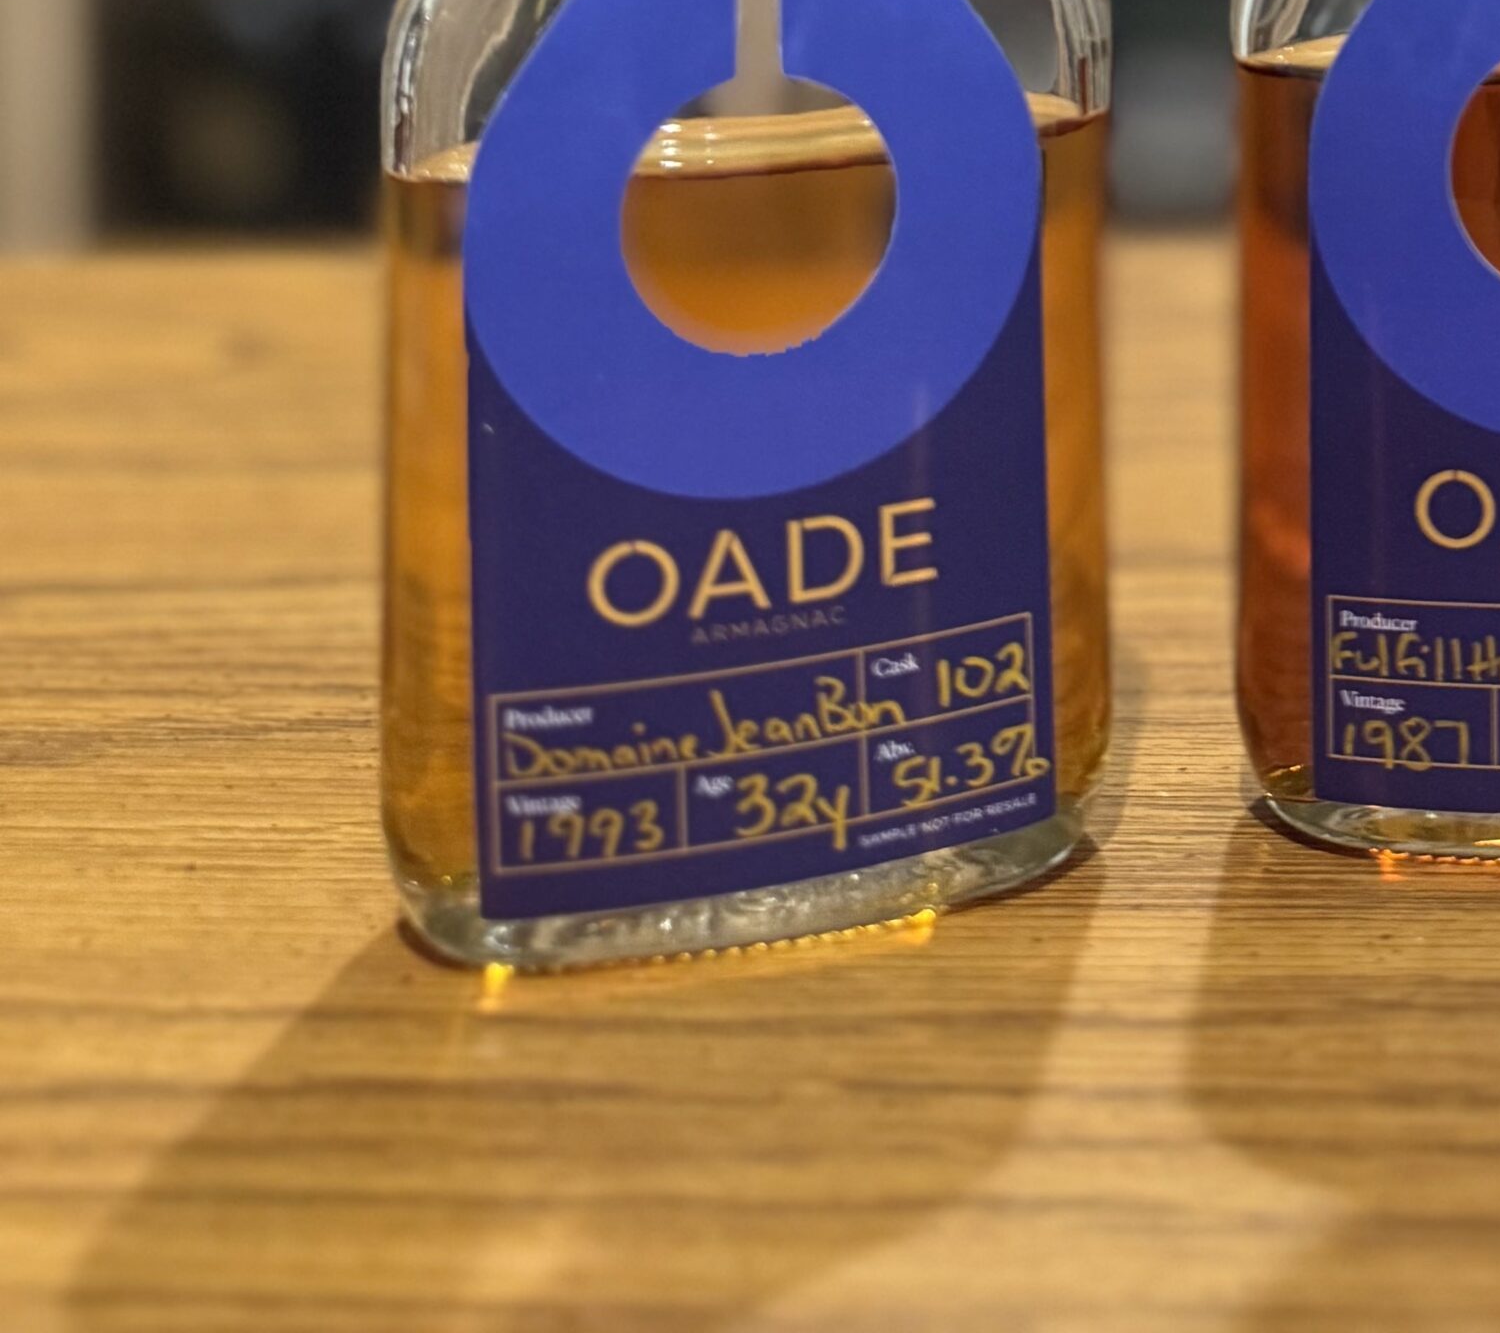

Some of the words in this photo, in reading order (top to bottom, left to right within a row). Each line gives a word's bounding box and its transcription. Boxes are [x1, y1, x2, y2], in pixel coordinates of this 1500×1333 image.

[588, 497, 938, 627] OADE
[691, 606, 848, 643] ARMAGNAC
[1339, 610, 1418, 631] Producer
[871, 653, 919, 677] Cask
[936, 642, 1030, 708] 102
[506, 704, 594, 728] Producer
[1340, 689, 1406, 713] Vintage
[1342, 716, 1470, 770] 1987
[892, 723, 1051, 808] 51.3%
[694, 774, 733, 800] Age
[518, 799, 666, 861] 1993
[921, 816, 949, 832] NOT
[953, 808, 982, 823] FOR
[985, 792, 1037, 816] RESALE
